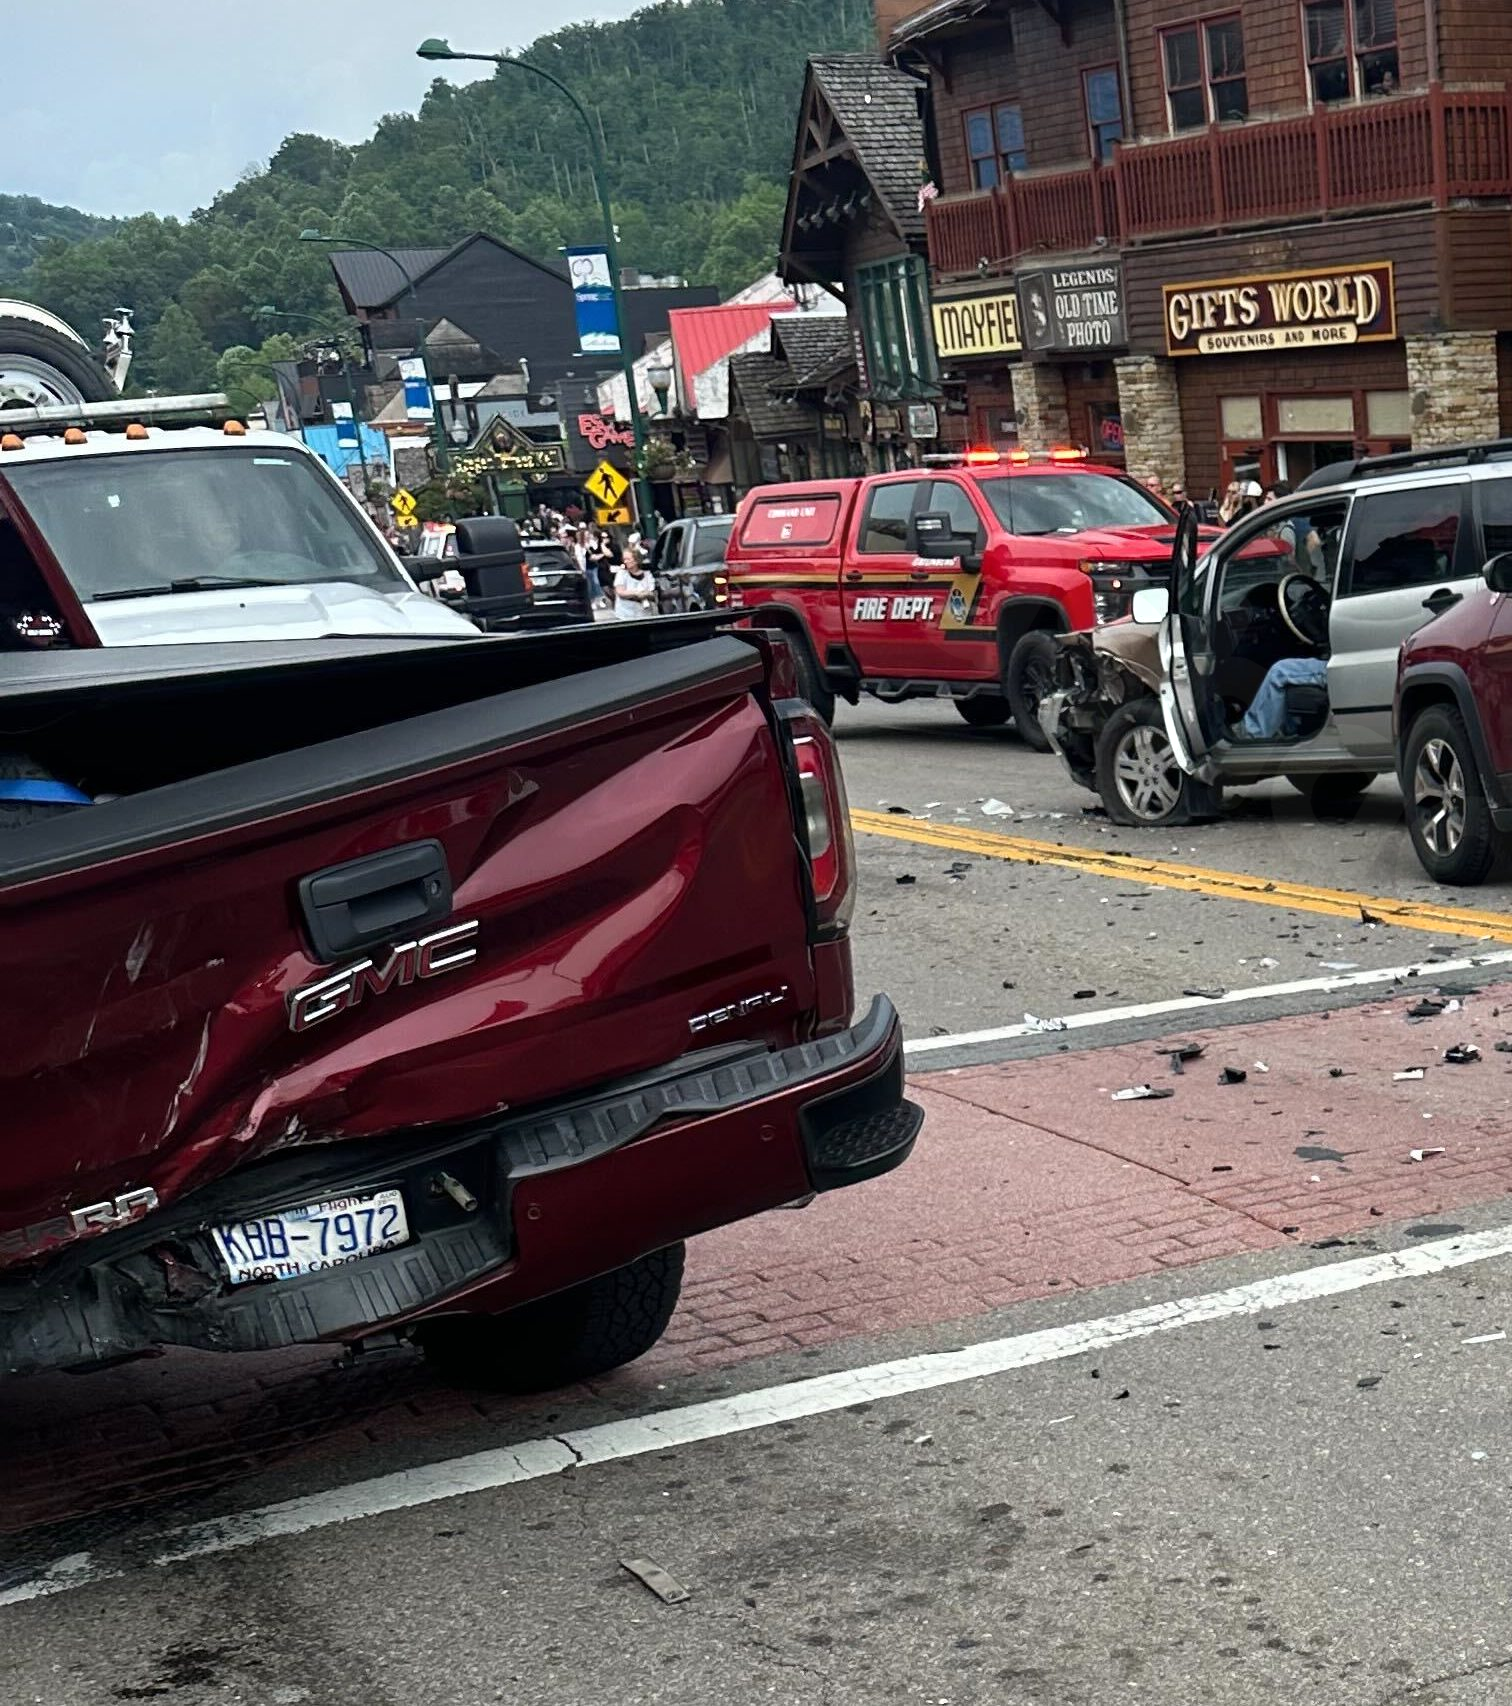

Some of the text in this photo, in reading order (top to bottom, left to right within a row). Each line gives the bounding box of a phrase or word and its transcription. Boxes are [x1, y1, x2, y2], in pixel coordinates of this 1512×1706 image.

[1052, 268, 1115, 288] LEGENDS
[1055, 289, 1118, 319] OLD TIME
[1169, 273, 1381, 340] GIFTS WORLD
[940, 299, 1021, 350] MAYFIEL
[1066, 320, 1112, 347] PHOTO
[1207, 326, 1348, 350] SOUVENIRS AND MORE
[853, 597, 935, 621] FIRE DEPT.
[285, 920, 479, 1032] GMC
[688, 985, 788, 1033] DENALI
[319, 1197, 363, 1213] Fligh
[218, 1204, 401, 1266] KBB-7972
[238, 1261, 301, 1281] NORTH
